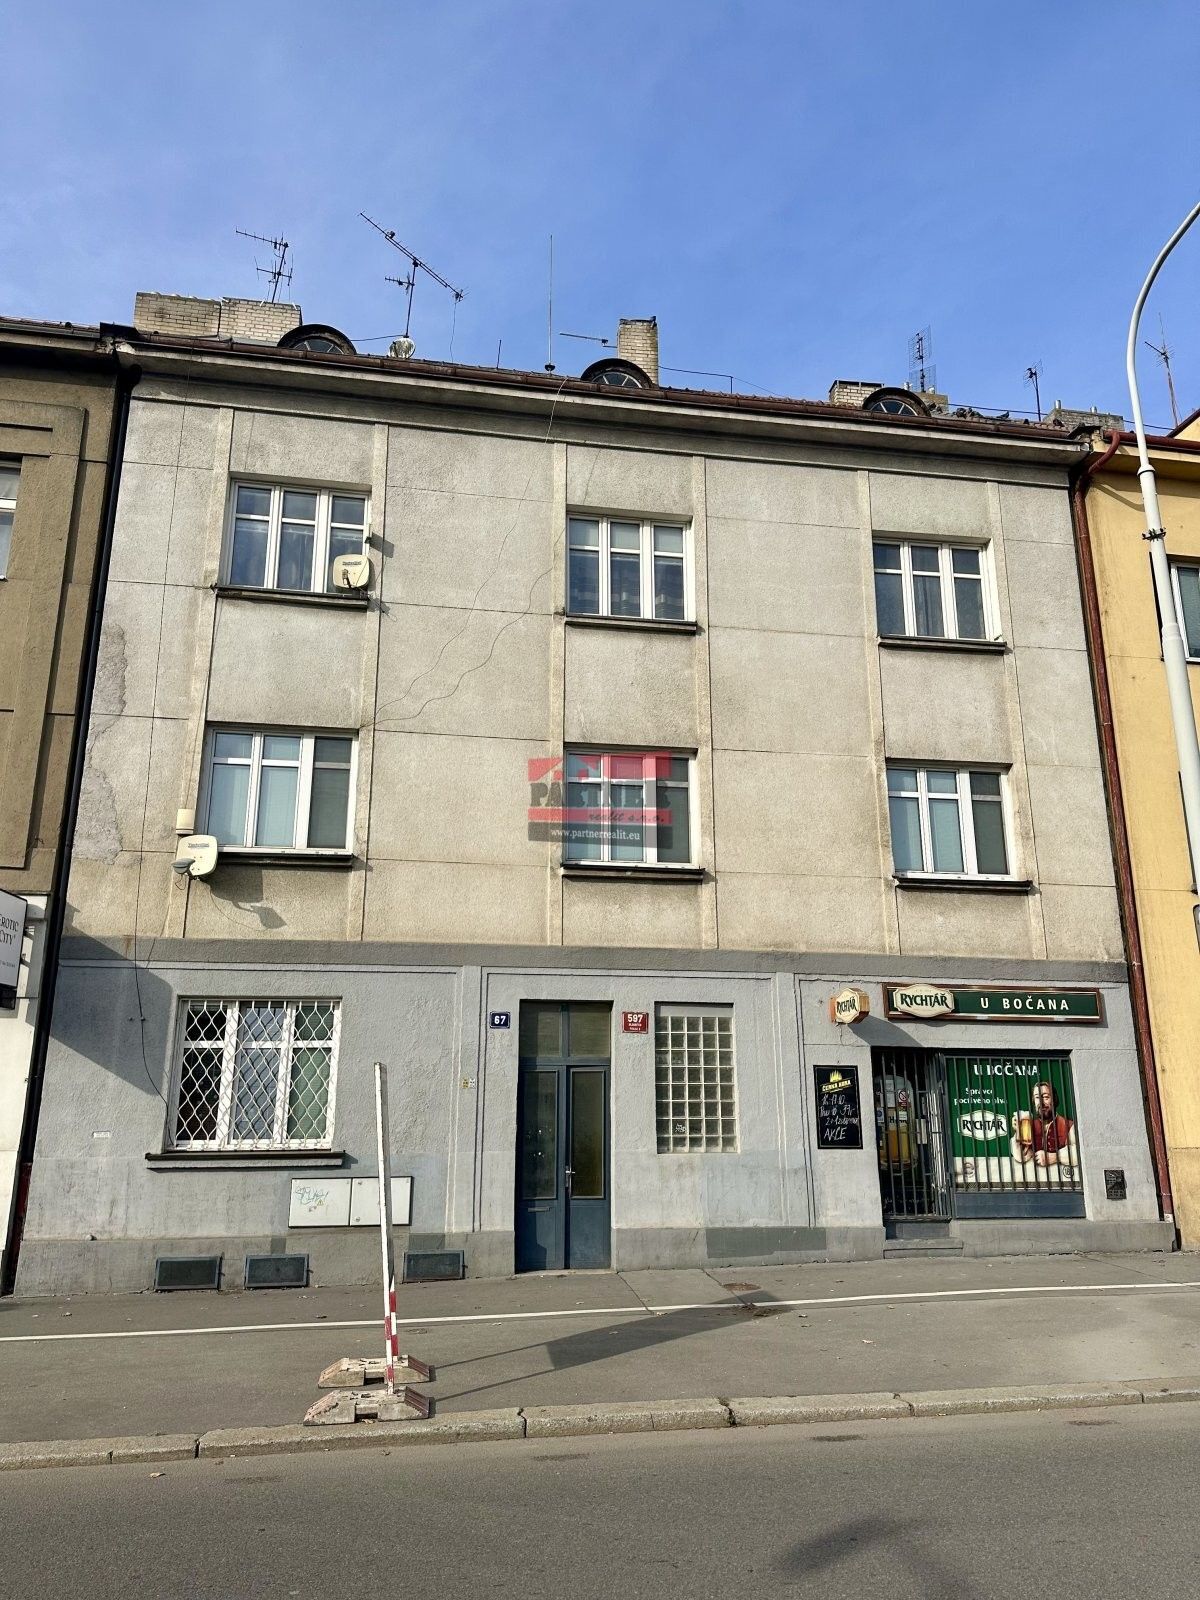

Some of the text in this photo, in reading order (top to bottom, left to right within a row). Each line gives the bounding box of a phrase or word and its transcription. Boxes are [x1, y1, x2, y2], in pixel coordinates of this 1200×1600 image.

[836, 997, 858, 1015] RYCHTÁŘ
[899, 993, 951, 1009] RYCHTÁŘ
[980, 995, 1069, 1010] U BOČANA
[494, 1015, 507, 1025] 67
[627, 1013, 643, 1023] 597
